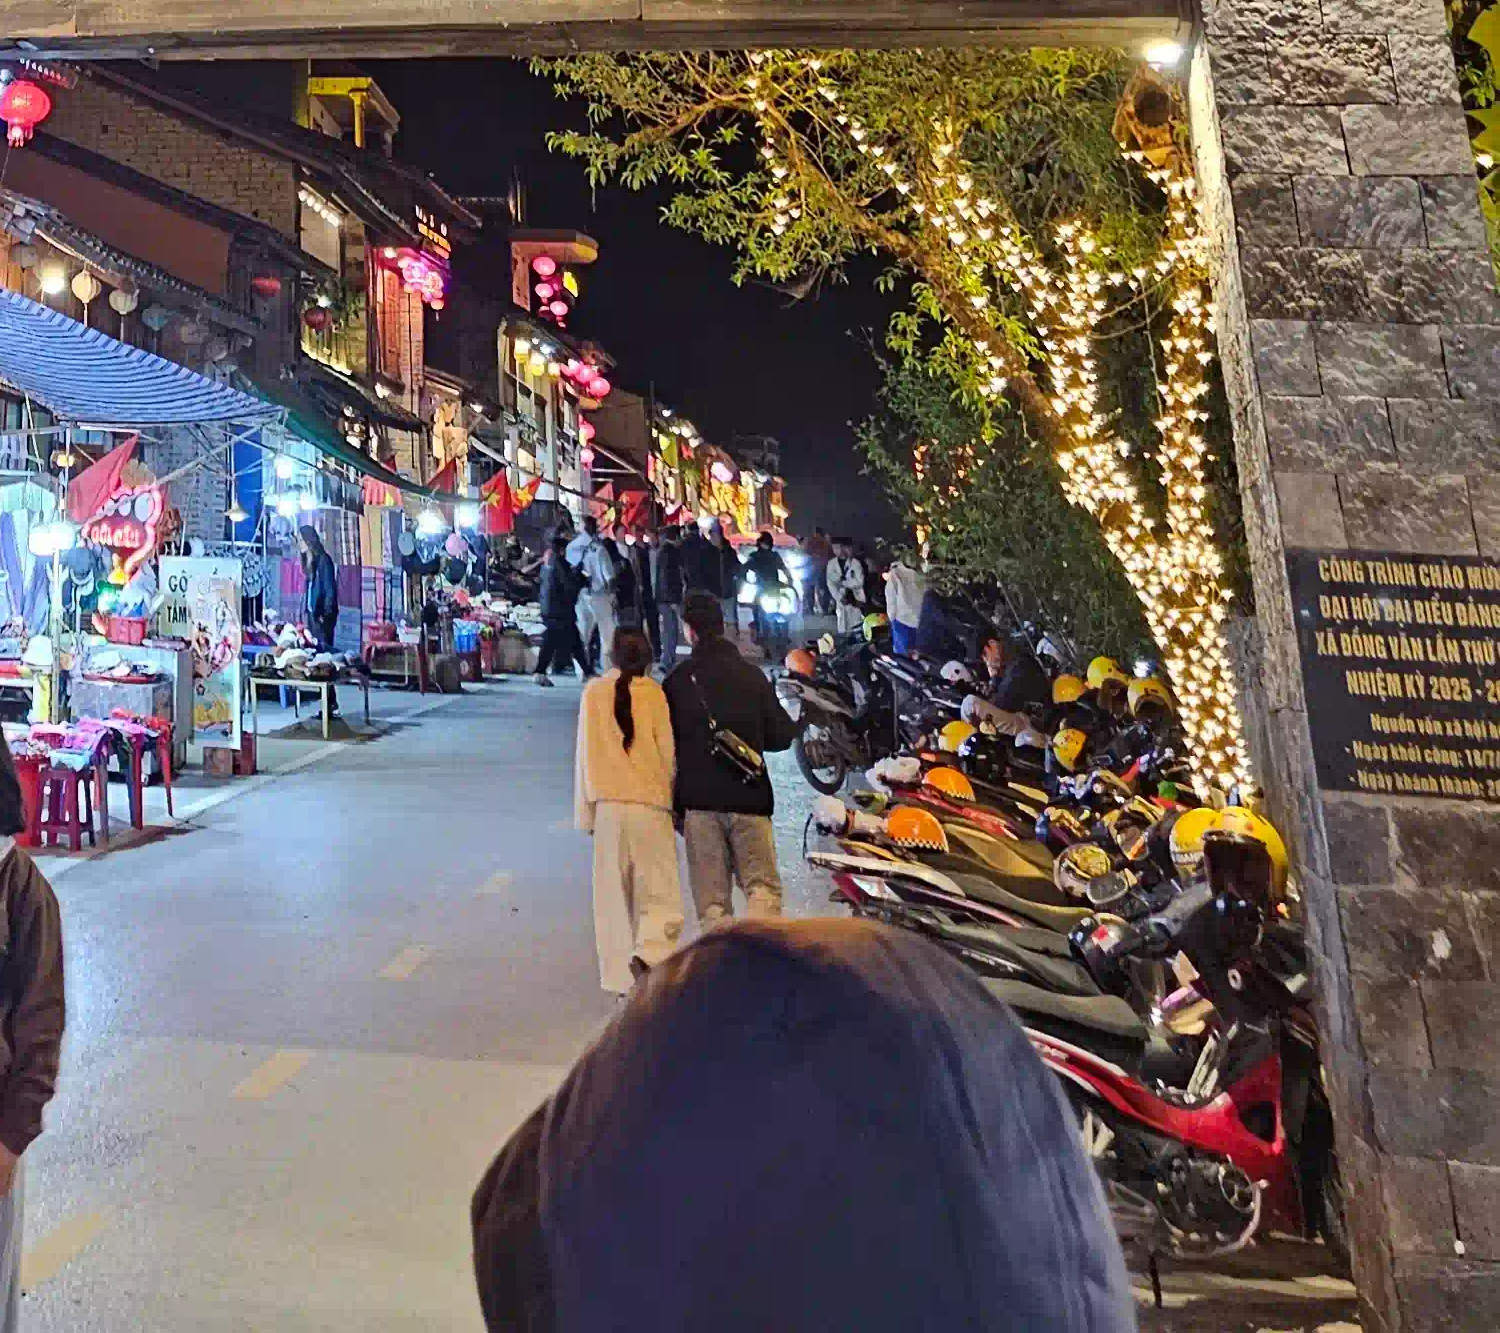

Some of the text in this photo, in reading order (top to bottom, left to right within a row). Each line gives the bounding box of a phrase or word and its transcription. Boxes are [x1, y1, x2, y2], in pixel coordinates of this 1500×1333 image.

[168, 569, 189, 598] GỘ
[1318, 554, 1364, 583] CÔNG
[1365, 557, 1417, 586] TRÌNH
[1419, 558, 1464, 589] CHÀO
[1319, 591, 1500, 628] ĐẠI HỘI ĐẠI BIỂU ĐẢNG
[1315, 627, 1339, 656] XÃ
[1340, 625, 1388, 659] ĐỒNG
[1388, 631, 1424, 661] VĂN
[1426, 629, 1461, 664] LẦN
[1346, 667, 1402, 701] NHIỆM
[1403, 669, 1425, 700] KỲ
[1429, 675, 1473, 702] 2025
